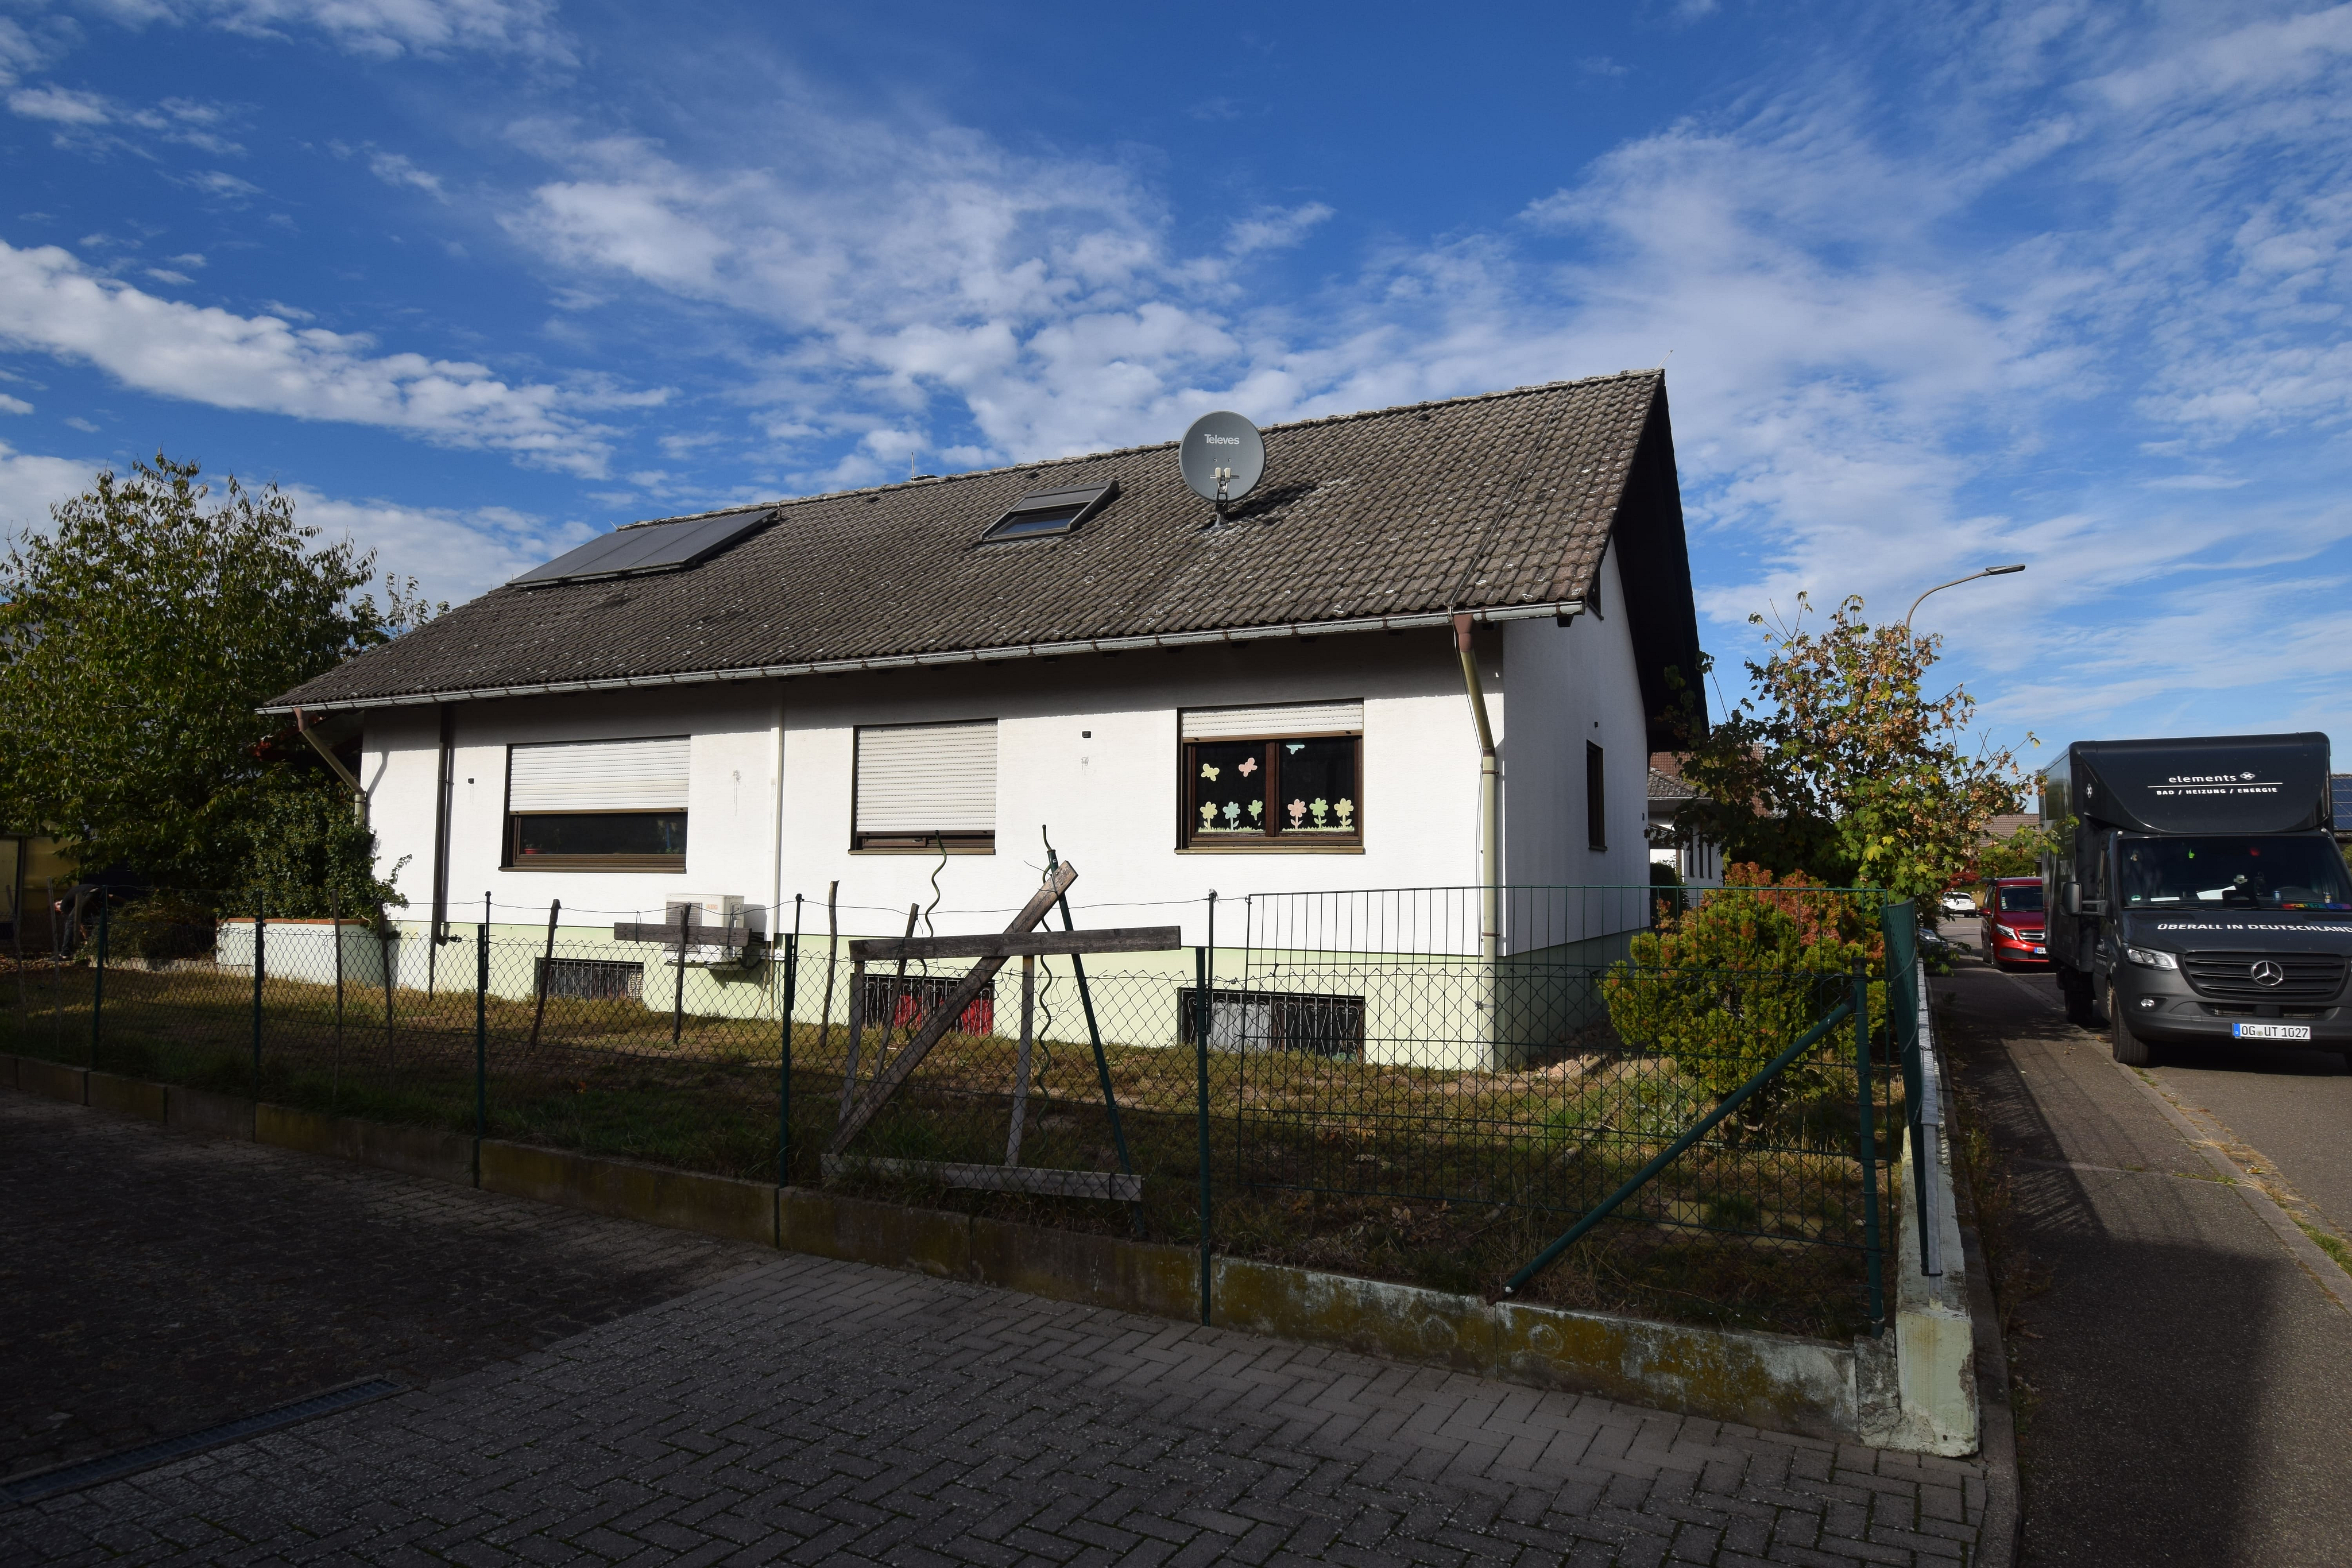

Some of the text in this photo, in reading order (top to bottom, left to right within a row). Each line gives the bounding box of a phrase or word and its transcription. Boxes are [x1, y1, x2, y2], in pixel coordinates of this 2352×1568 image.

[1204, 433, 1240, 445] Televes
[2168, 775, 2237, 783] elements
[2247, 924, 2352, 932] DEUTSCHLAND
[2241, 1025, 2308, 1038] OG UT 1027
